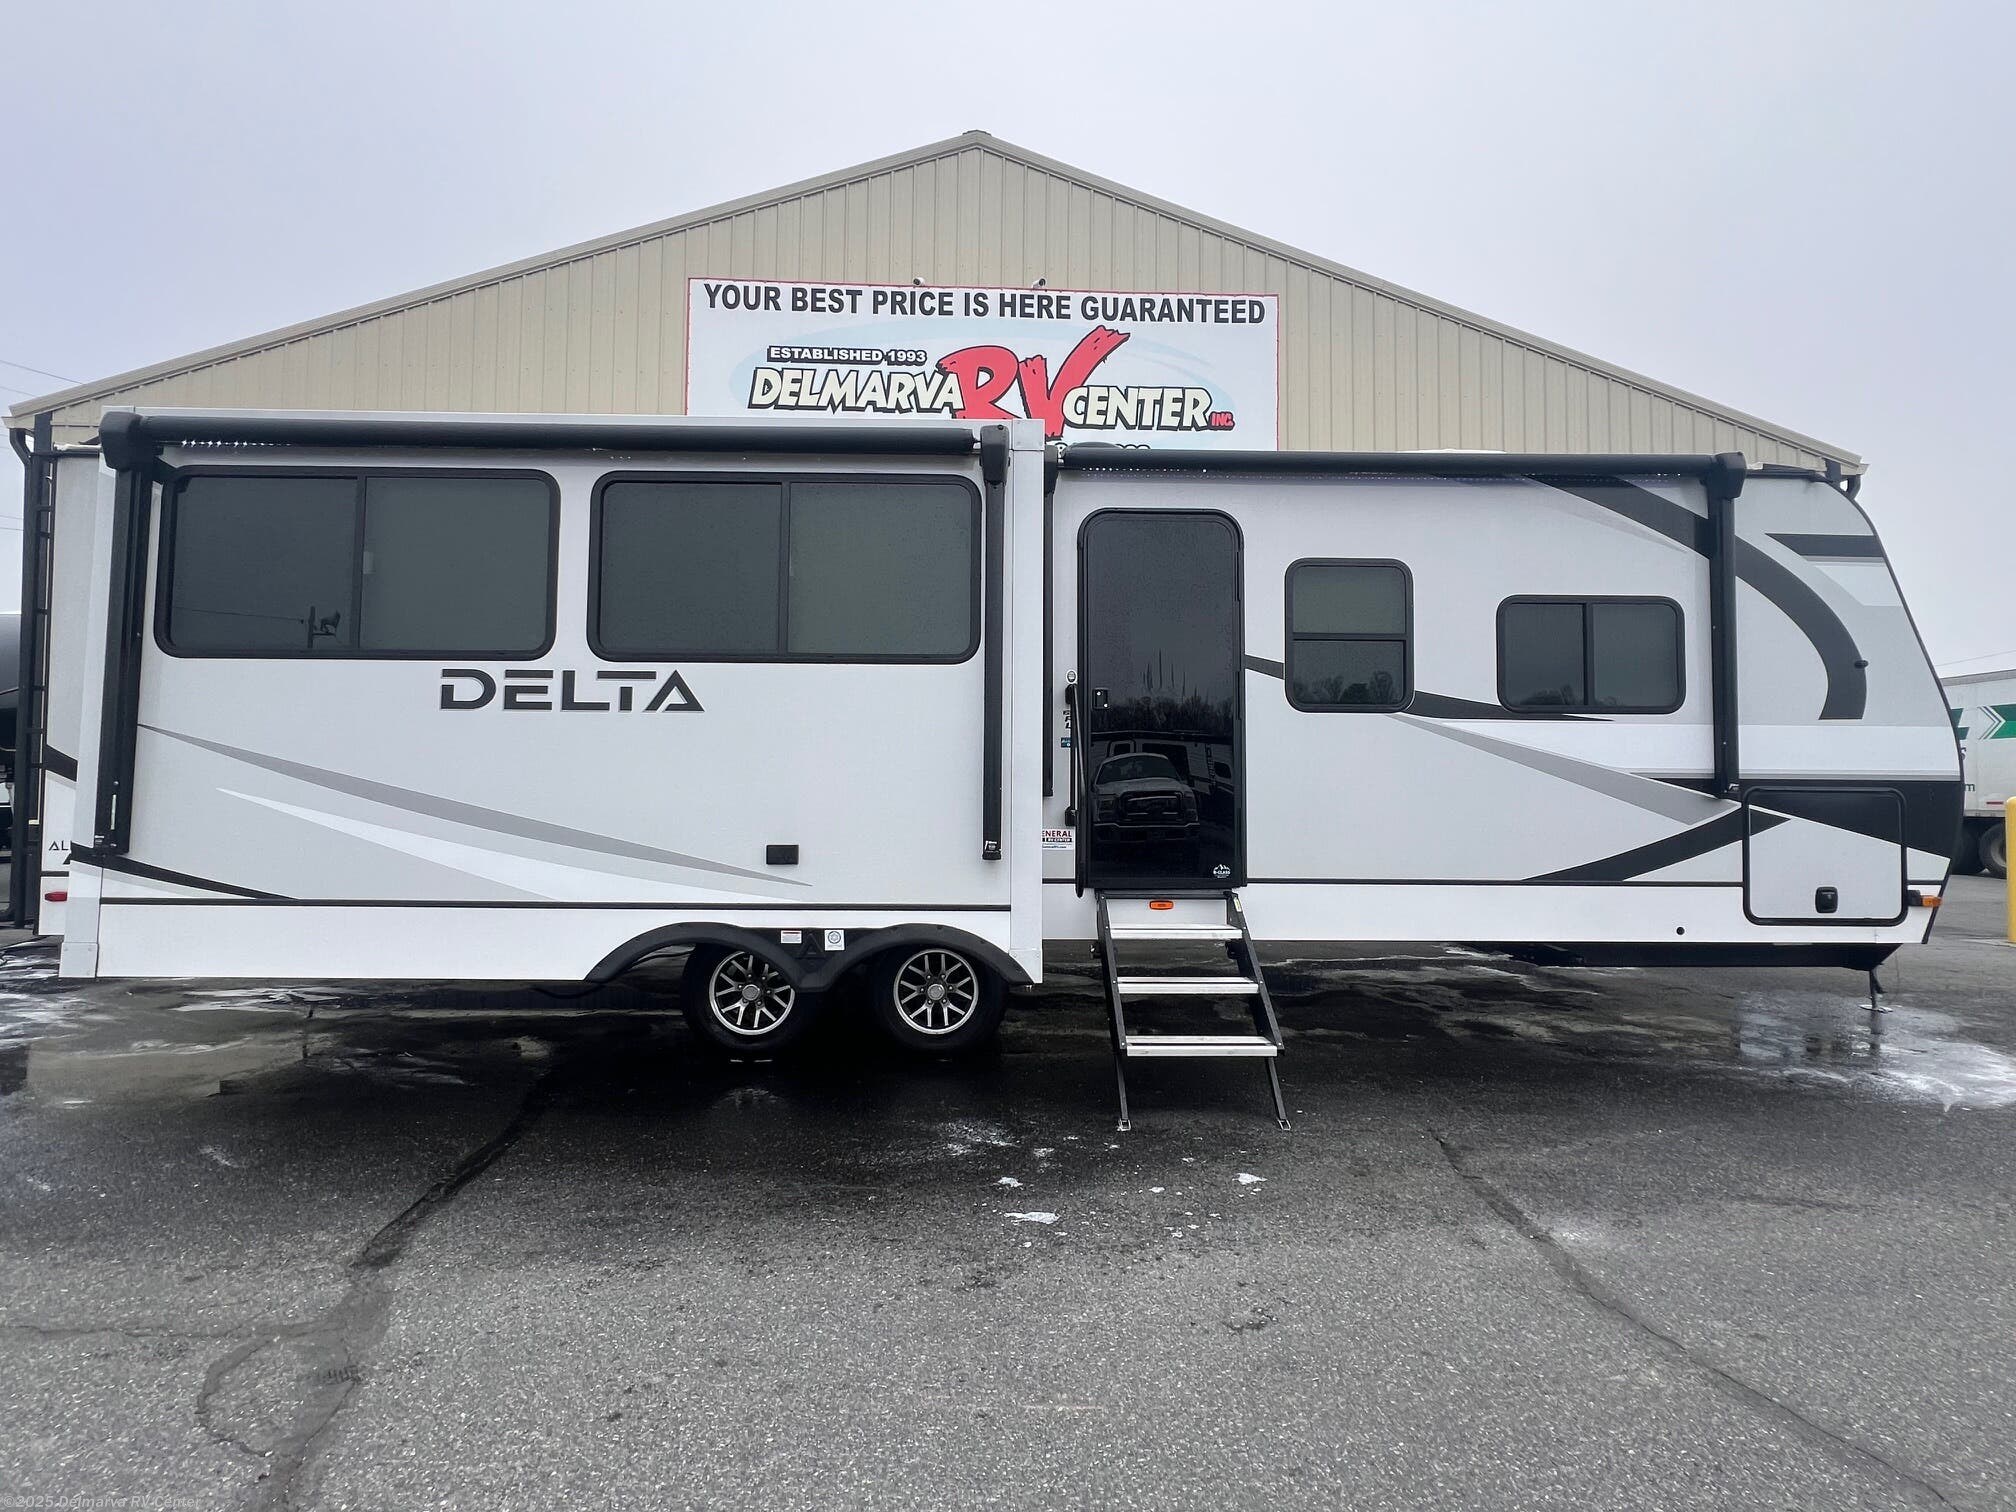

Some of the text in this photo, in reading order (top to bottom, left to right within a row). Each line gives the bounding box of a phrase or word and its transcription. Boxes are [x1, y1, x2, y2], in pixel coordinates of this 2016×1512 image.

[703, 283, 1266, 323] YOUR BEST PRICE IS HERE GUARANTEED
[769, 346, 927, 364] ESTABLISHED 1993
[749, 367, 965, 413] DELMARVA
[937, 325, 1131, 440] RV
[1062, 385, 1212, 431] CENTER
[440, 668, 705, 712] DELTA
